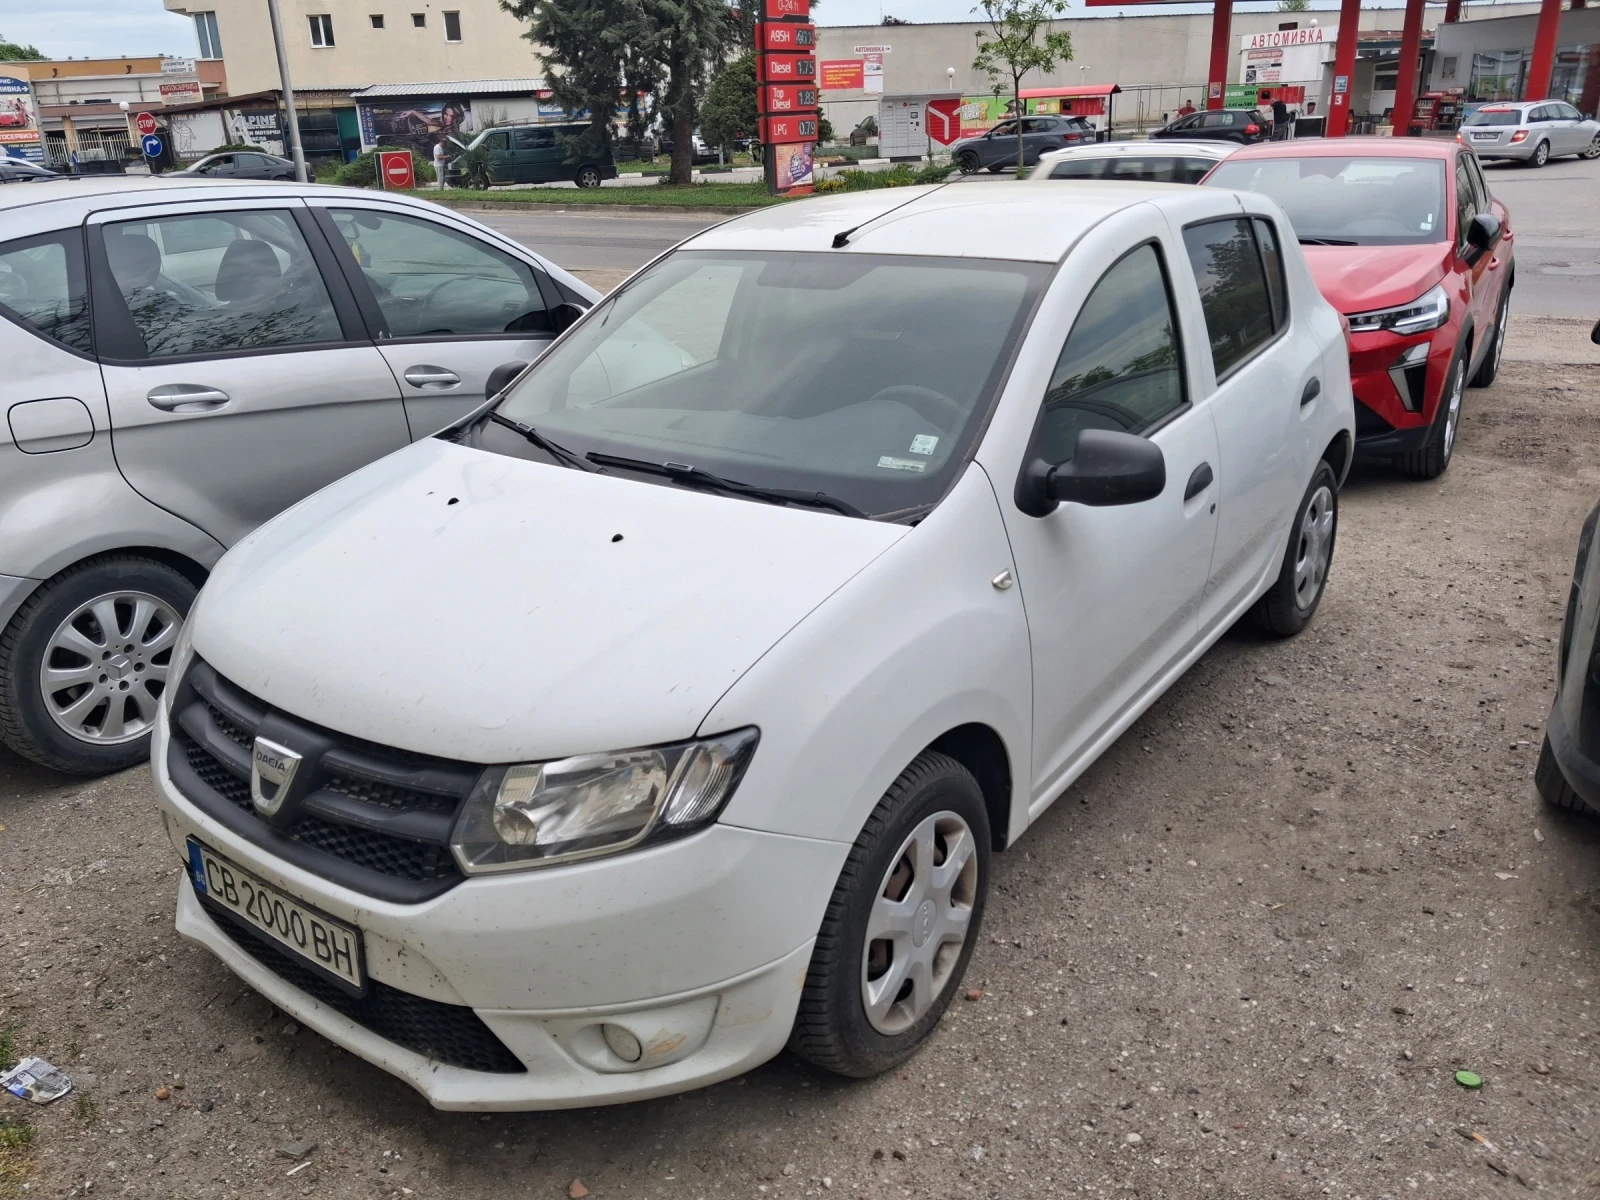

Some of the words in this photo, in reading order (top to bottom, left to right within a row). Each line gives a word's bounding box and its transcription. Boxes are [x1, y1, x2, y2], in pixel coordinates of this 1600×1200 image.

[777, 0, 793, 11] 0-24
[770, 29, 790, 42] A95H
[1250, 28, 1323, 48] АВТОМИВКА
[771, 61, 791, 74] Diesel
[797, 61, 814, 75] 1.75
[772, 87, 784, 99] Top
[798, 91, 815, 105] 1.83
[1334, 95, 1342, 105] 3
[772, 99, 791, 110] Diesel
[138, 119, 154, 129] STOP
[773, 124, 787, 135] LPG
[799, 121, 815, 135] 0.79
[256, 751, 286, 772] DACIA
[195, 871, 206, 885] BG
[205, 858, 240, 907] CB
[241, 880, 307, 949] 2000
[310, 919, 354, 978] BH
